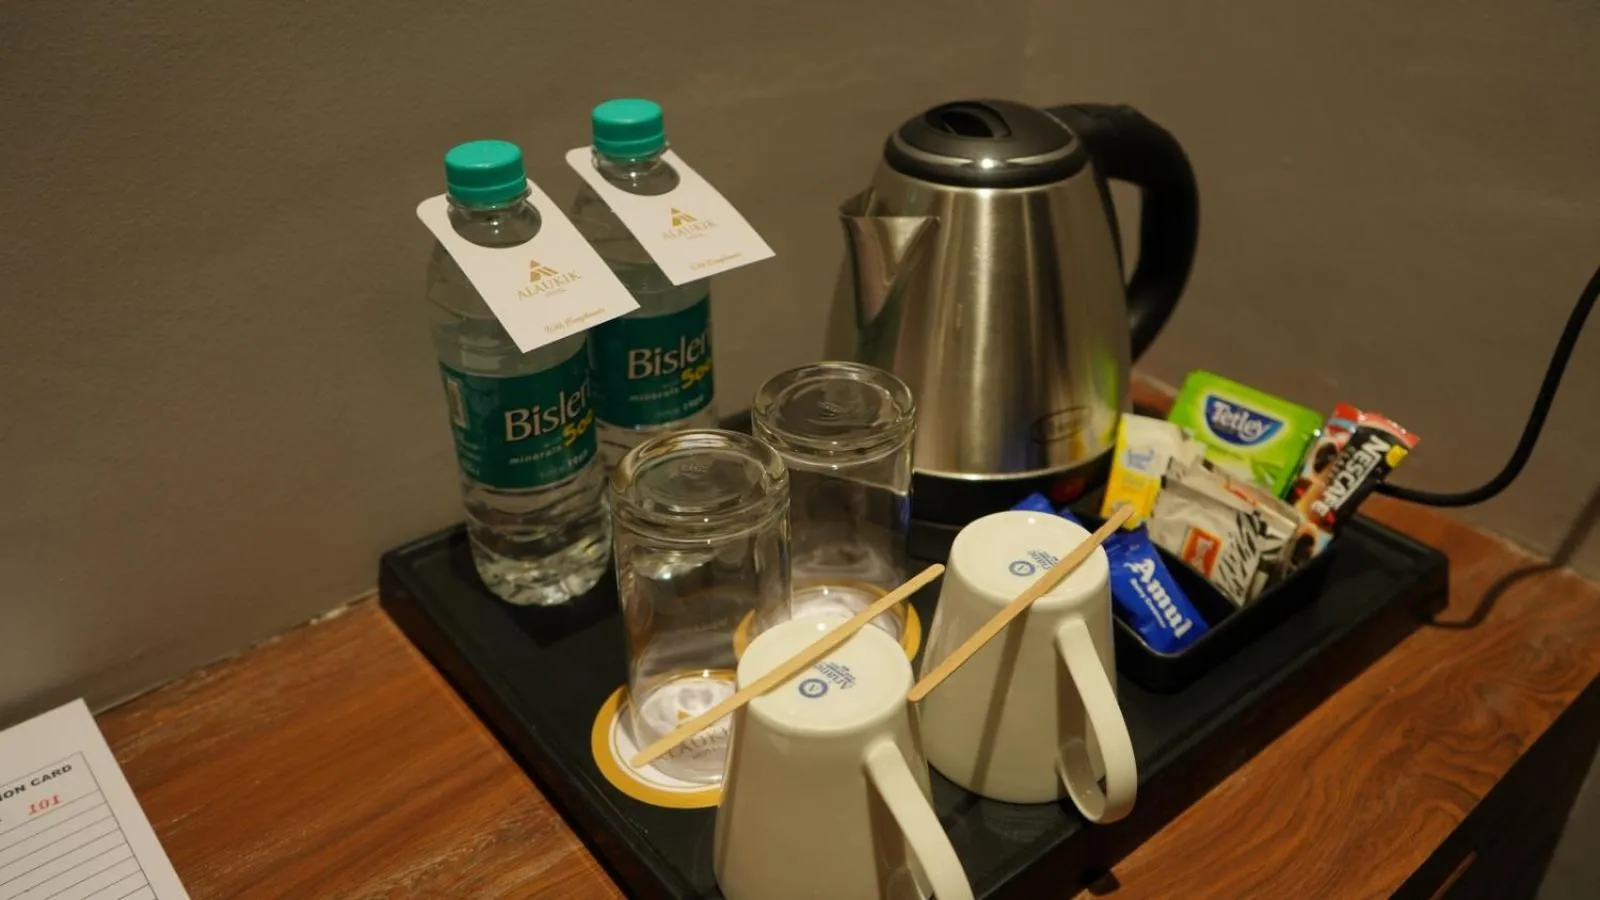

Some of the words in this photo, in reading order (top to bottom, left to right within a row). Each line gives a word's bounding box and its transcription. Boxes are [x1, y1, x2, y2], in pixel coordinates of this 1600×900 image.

[517, 270, 582, 301] ALAUKIK
[1211, 400, 1274, 442] Tetley
[1123, 558, 1194, 641] Amul
[30, 764, 72, 786] CARD
[28, 794, 63, 816] 101
